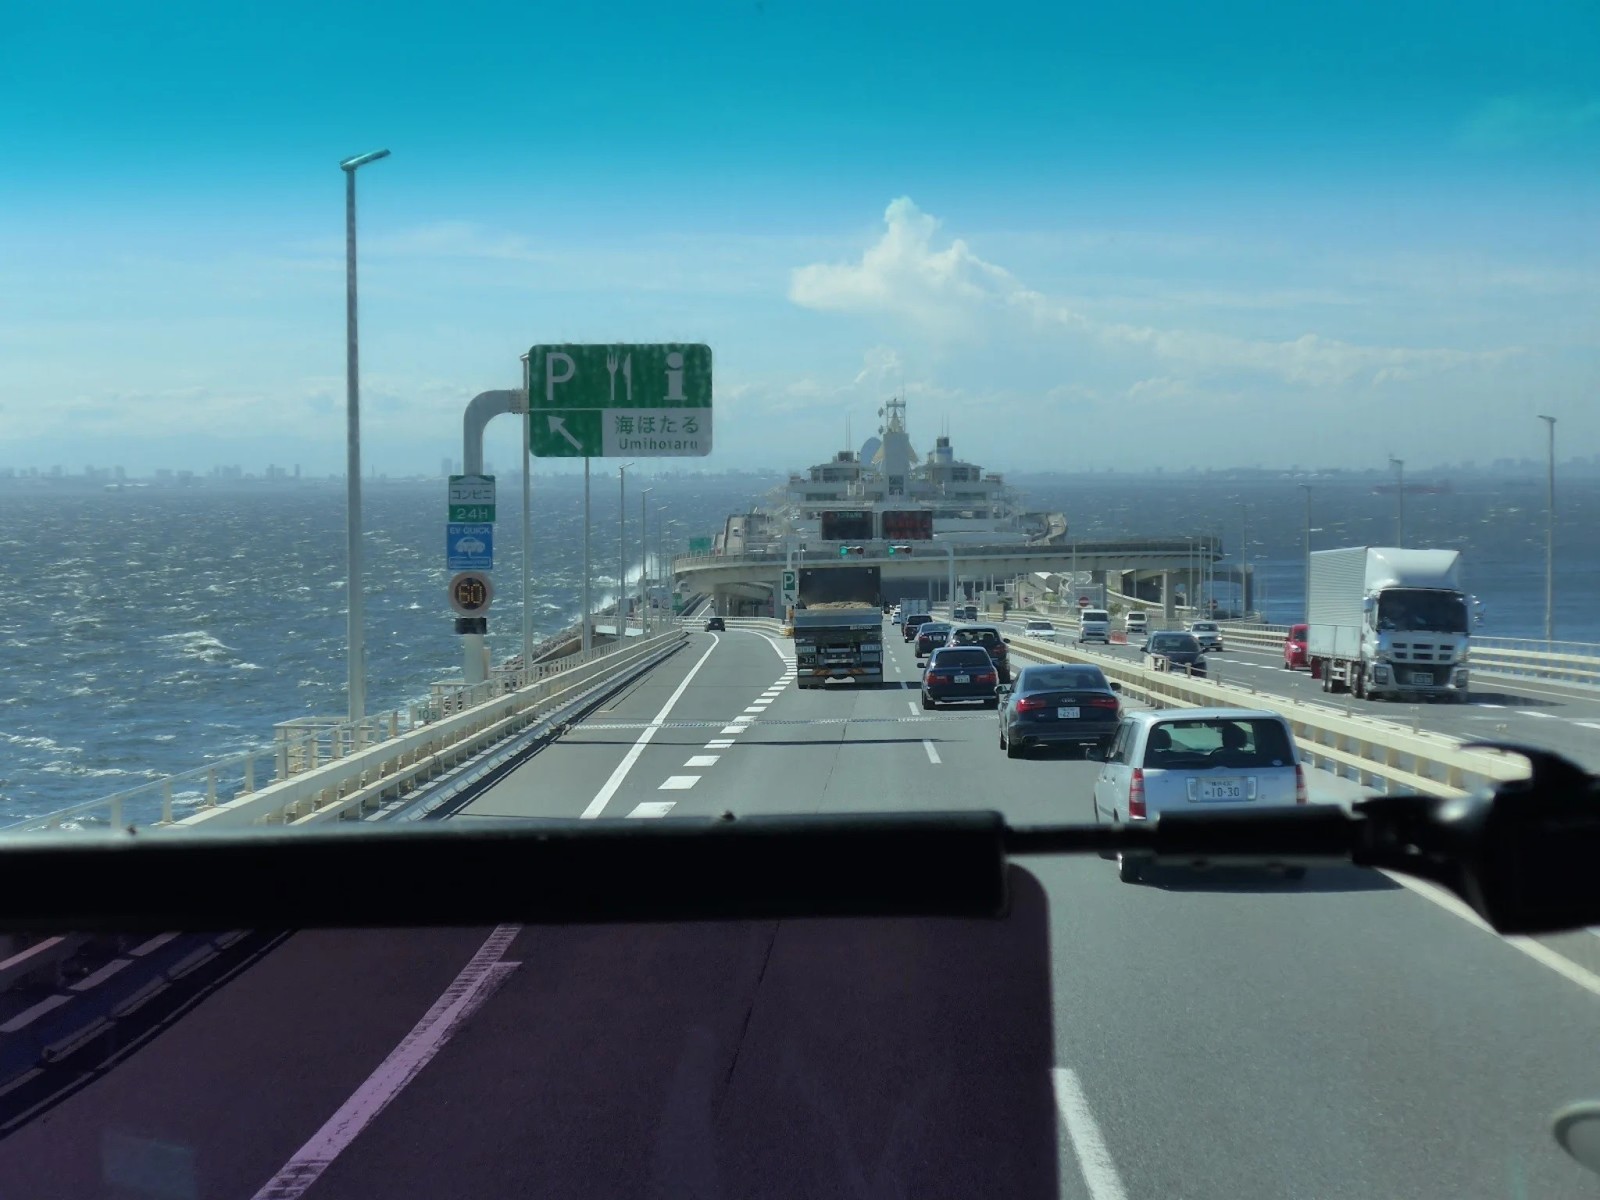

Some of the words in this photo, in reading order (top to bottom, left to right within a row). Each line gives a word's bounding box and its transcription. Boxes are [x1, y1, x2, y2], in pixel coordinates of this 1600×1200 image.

[546, 352, 576, 401] P
[615, 415, 699, 435] 海ほたる
[619, 438, 698, 450] Umihotaru
[452, 489, 492, 500] コンビニ
[457, 508, 488, 520] 24H
[449, 527, 461, 535] EV
[784, 573, 795, 589] P
[458, 584, 483, 603] 60
